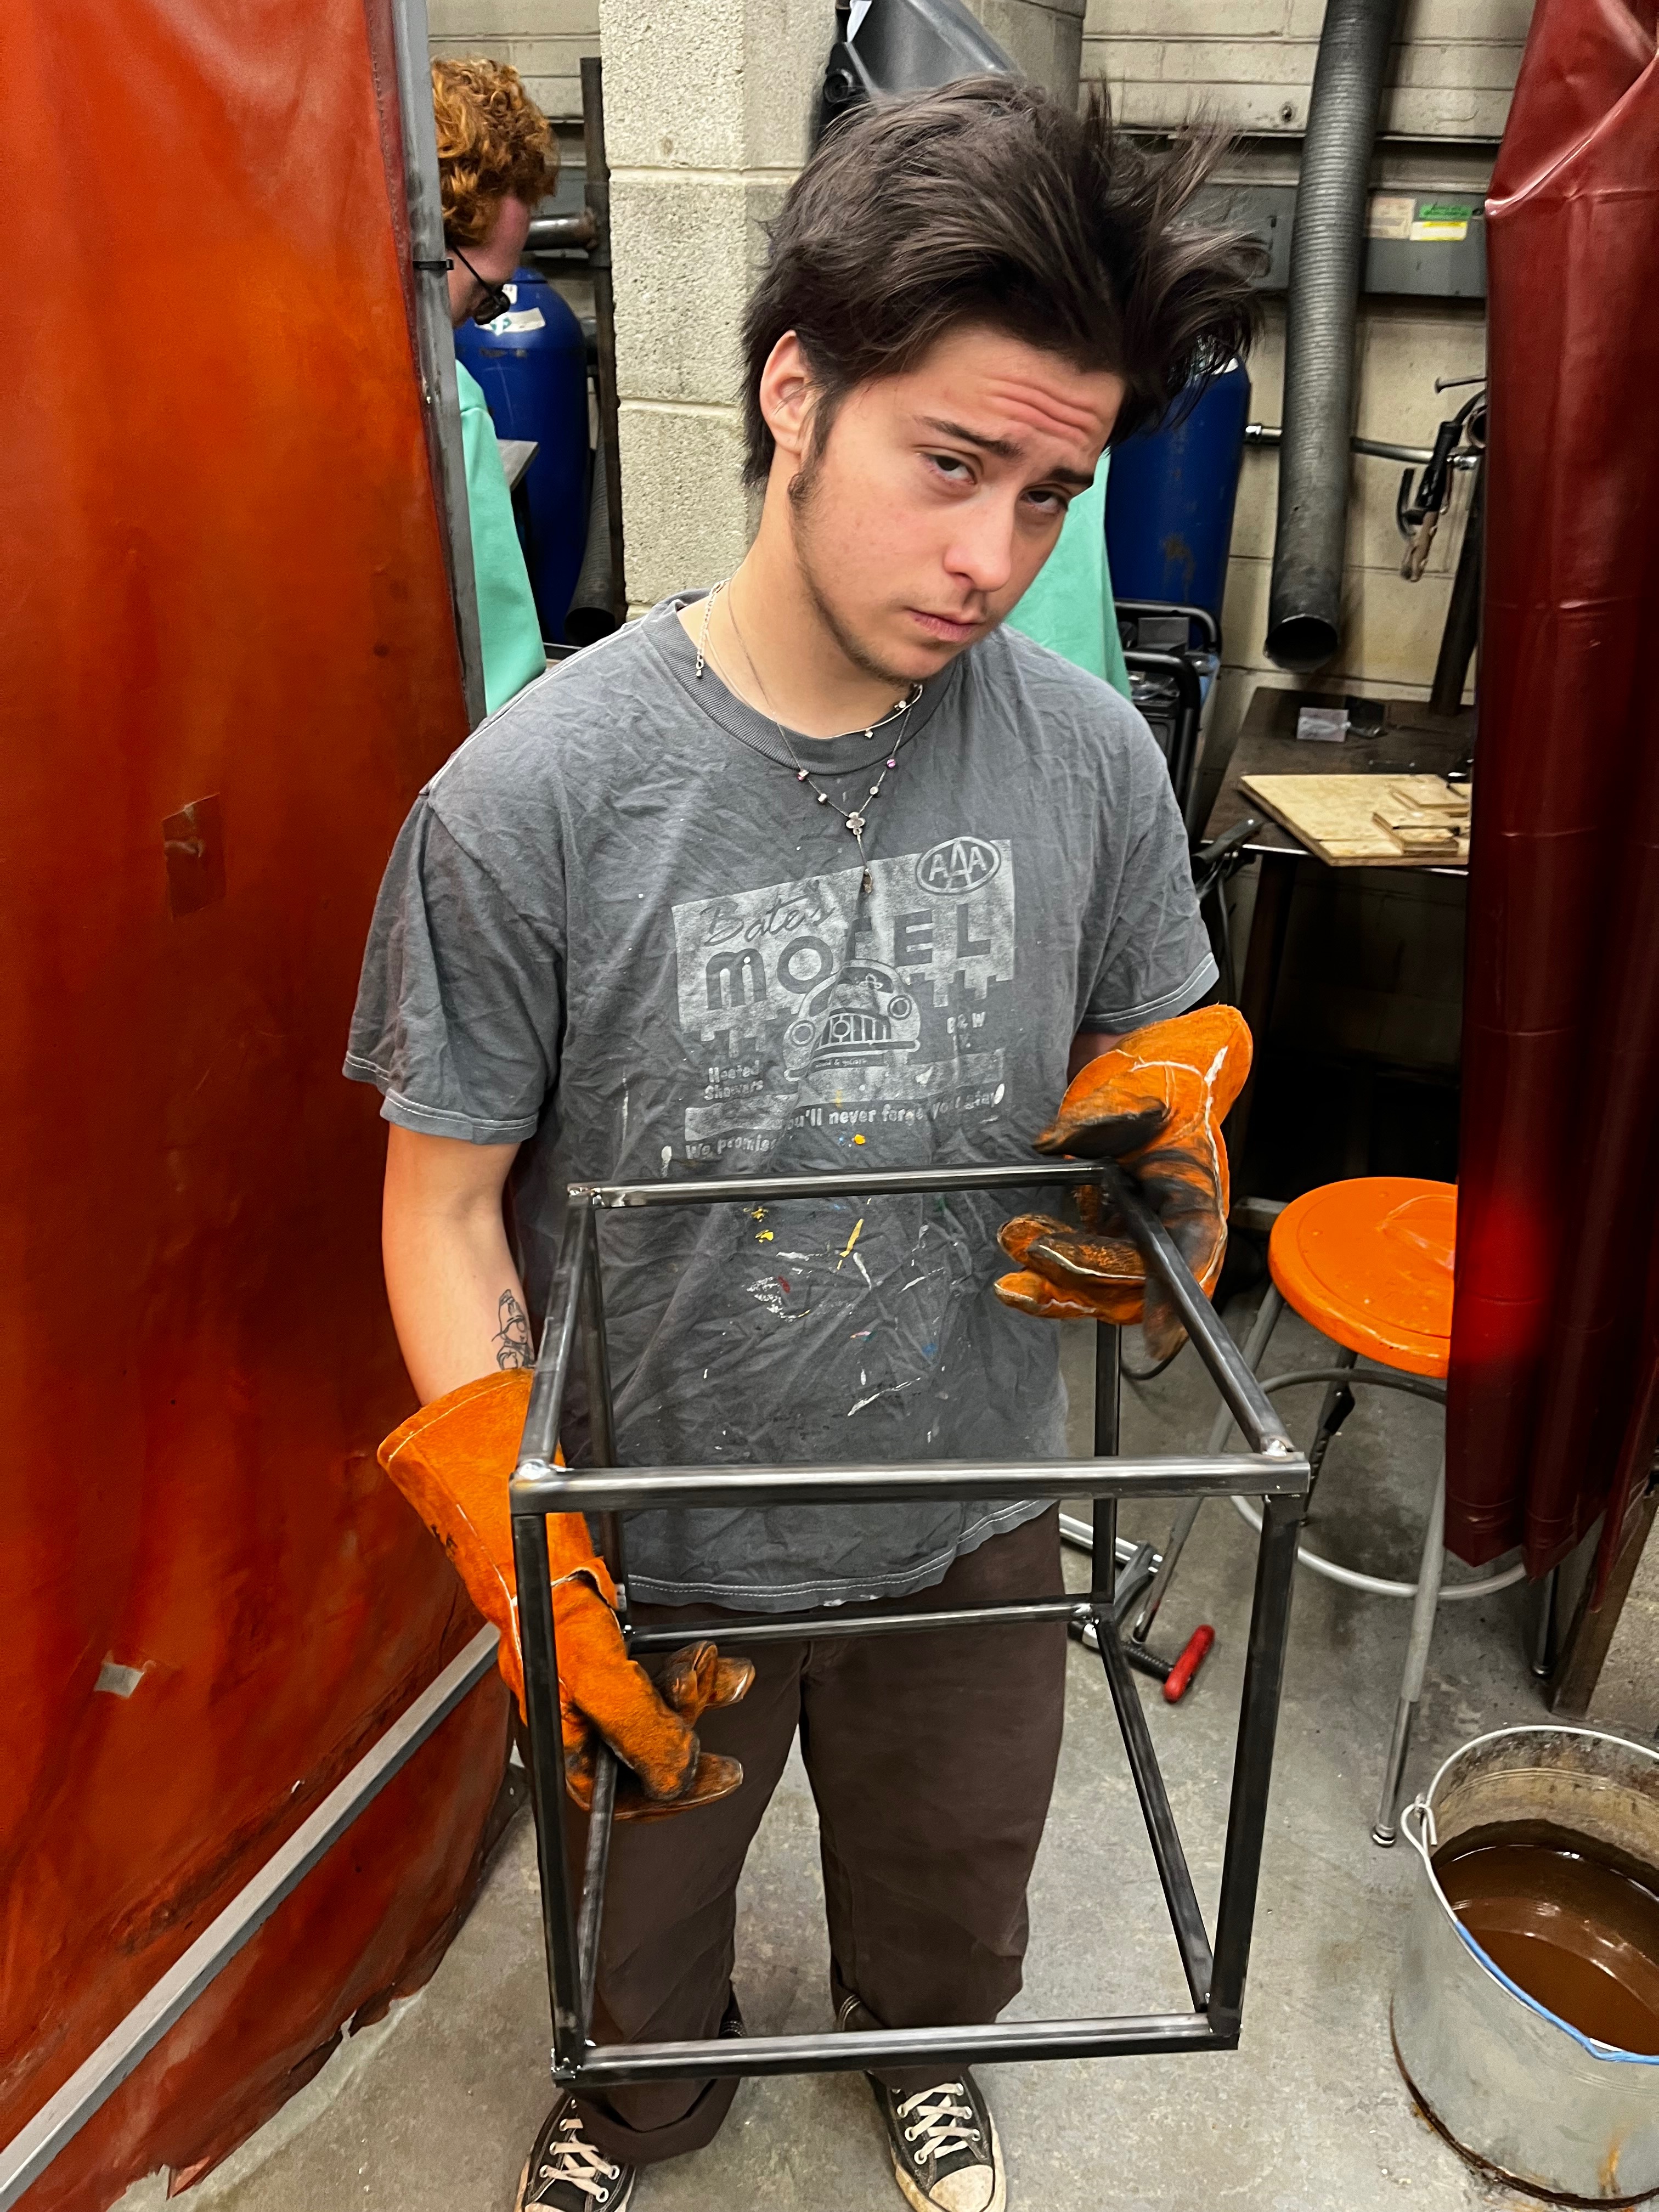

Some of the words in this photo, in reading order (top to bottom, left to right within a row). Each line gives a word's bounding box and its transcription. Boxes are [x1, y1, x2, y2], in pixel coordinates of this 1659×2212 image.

[928, 839, 987, 890] AAA
[972, 1012, 986, 1028] W
[708, 1060, 759, 1083] Heated
[686, 1143, 711, 1160] We
[785, 1108, 822, 1130] ou'll
[828, 1109, 877, 1125] never
[881, 1103, 925, 1126] forge
